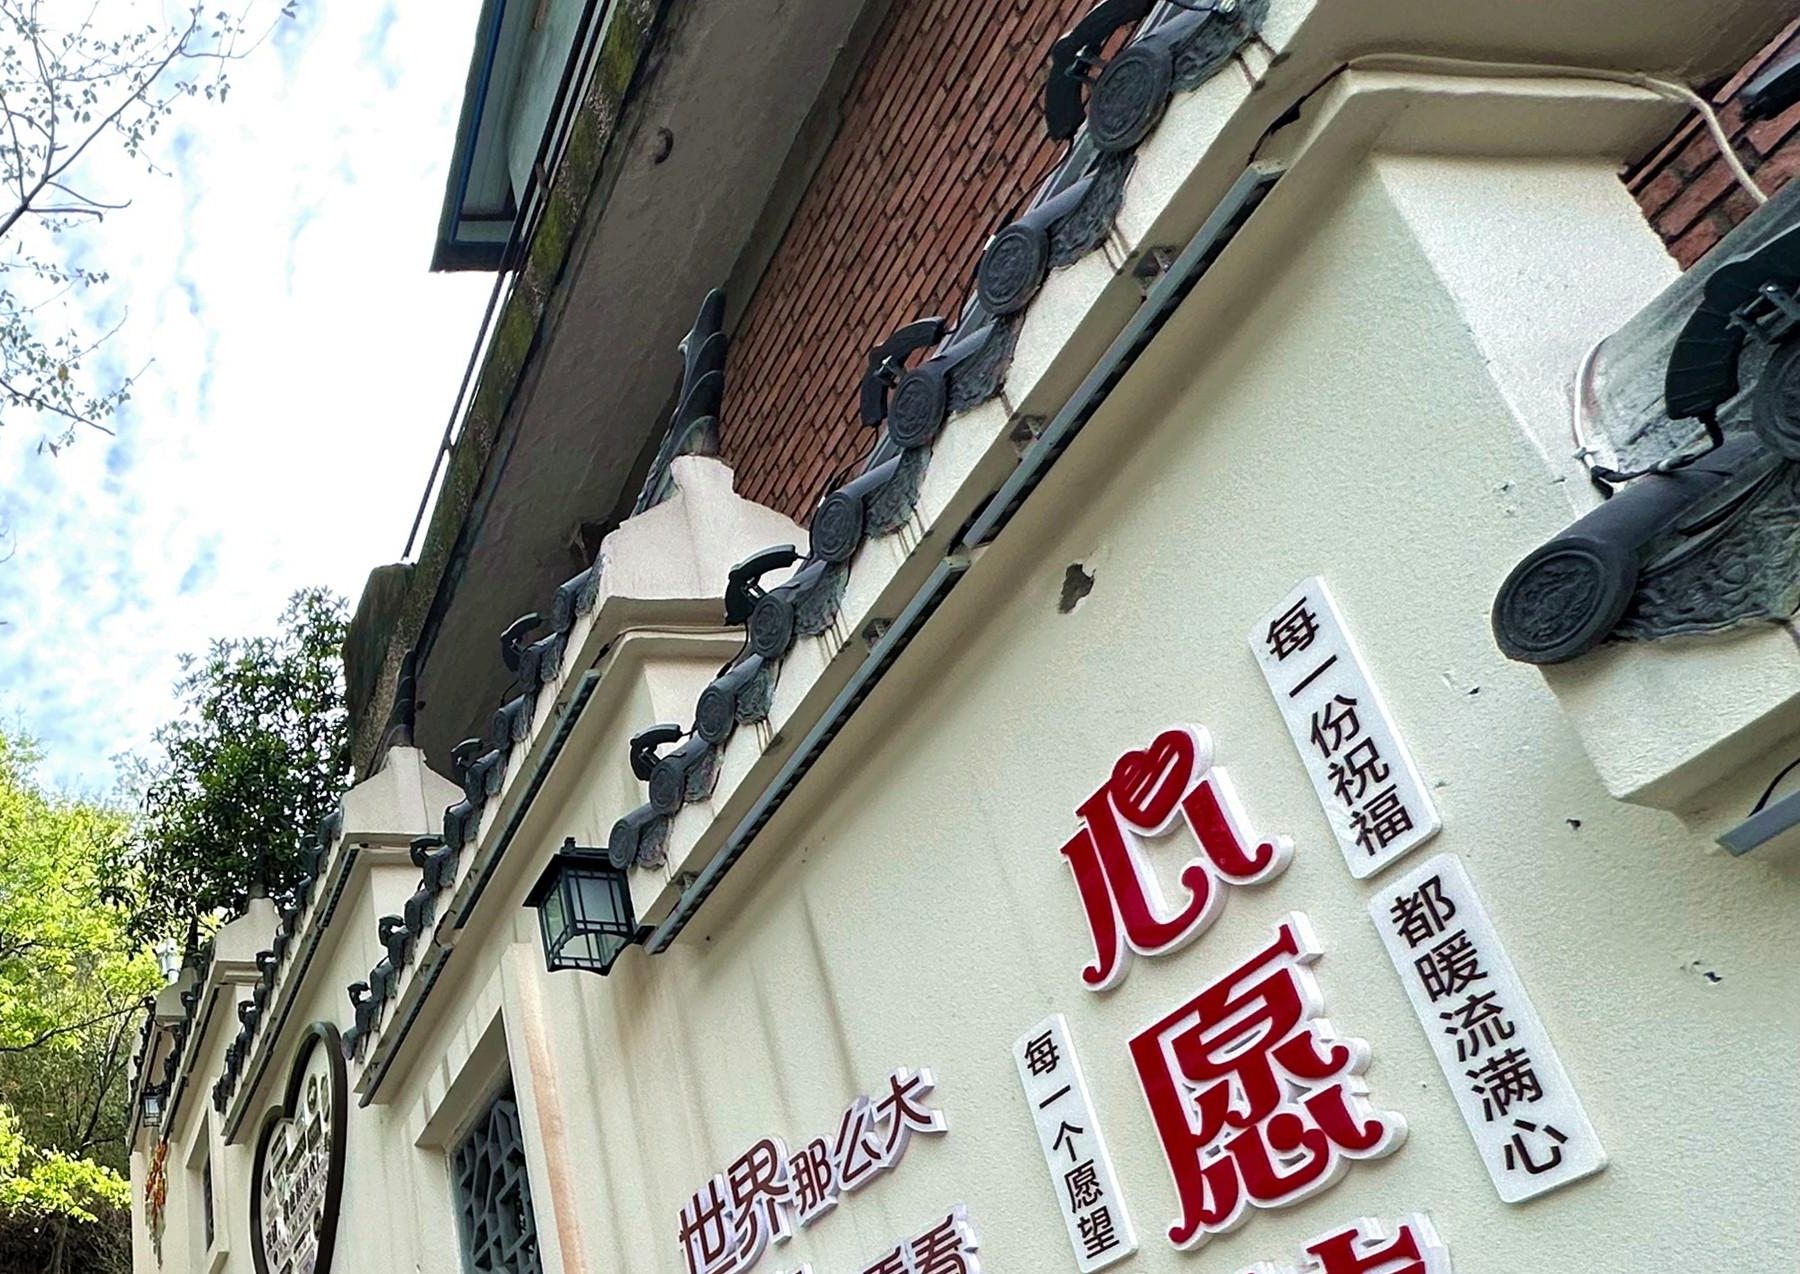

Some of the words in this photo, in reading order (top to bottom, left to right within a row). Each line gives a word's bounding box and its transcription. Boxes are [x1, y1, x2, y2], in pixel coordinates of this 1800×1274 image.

[1266, 596, 1414, 857] 每一份祝福
[1024, 1029, 1120, 1259] 每一个愿望
[1390, 875, 1569, 1174] 都暖流满心
